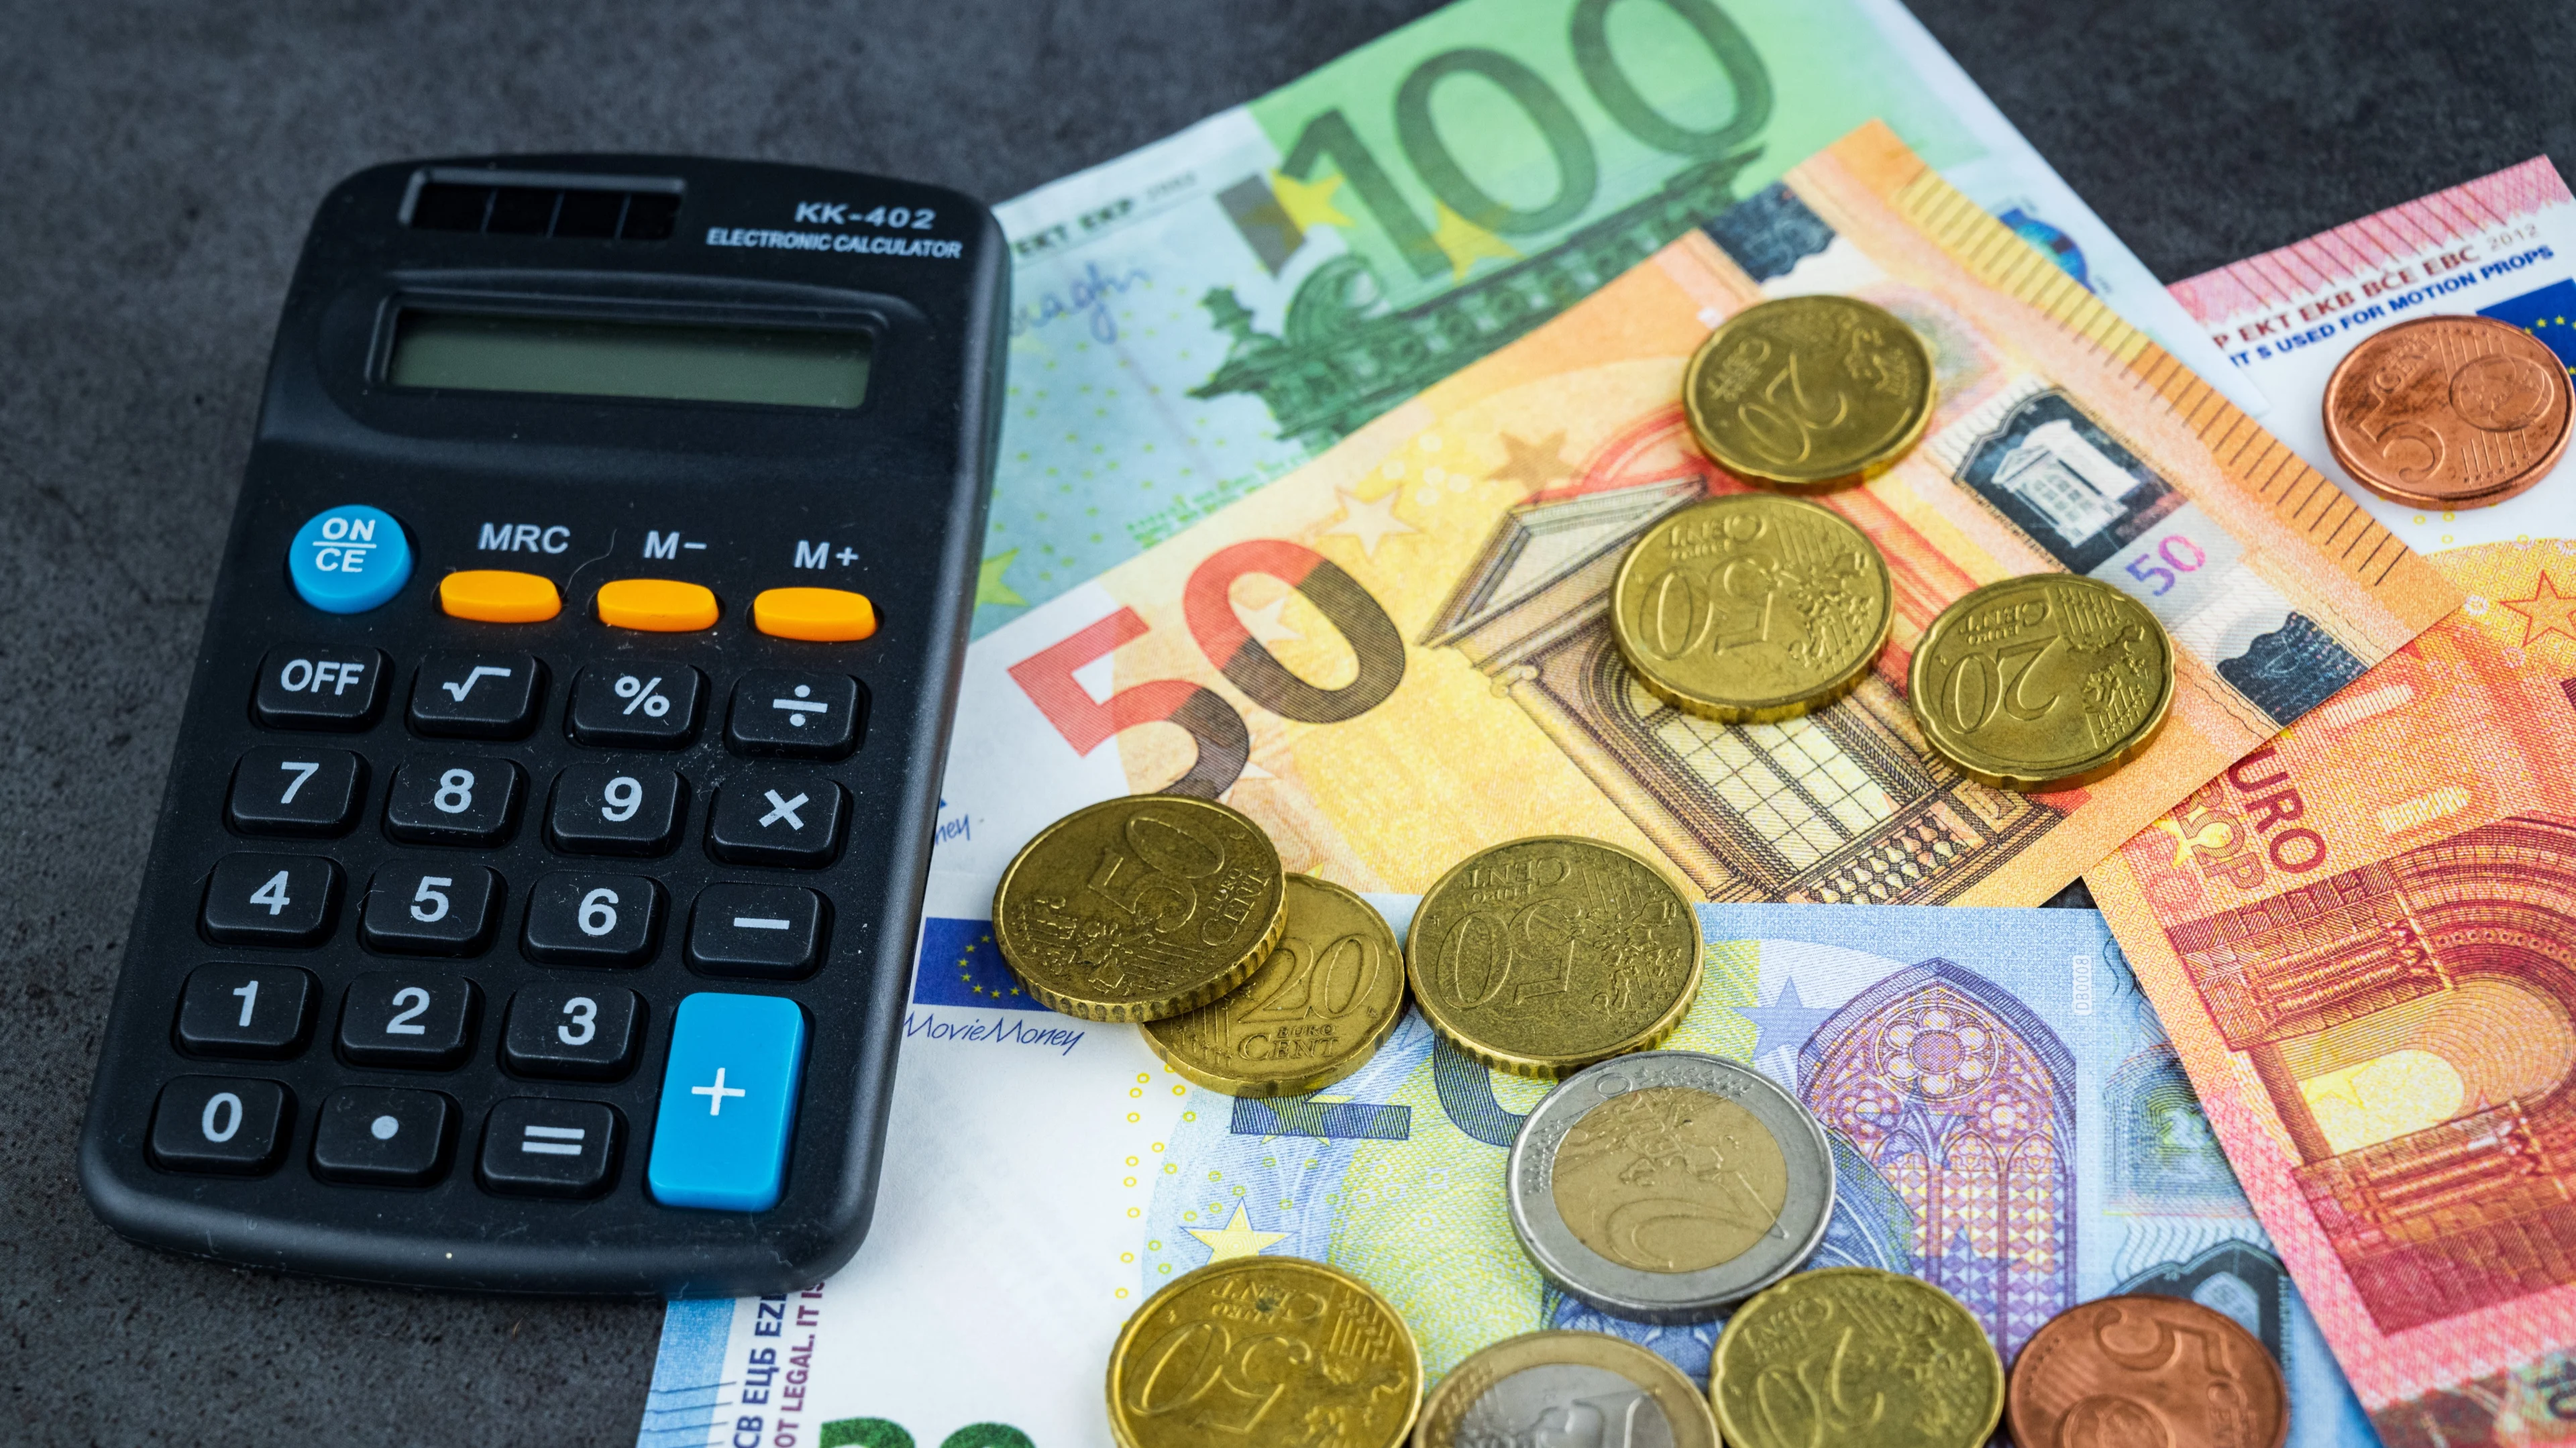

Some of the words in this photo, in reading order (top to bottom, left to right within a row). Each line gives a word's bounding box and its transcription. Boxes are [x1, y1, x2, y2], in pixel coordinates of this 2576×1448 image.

[1278, 0, 1774, 280] 100
[794, 201, 936, 230] KK-402
[706, 227, 832, 252] ELECTRONIC
[833, 234, 963, 260] CALCULATOR
[2237, 314, 2292, 342] EKT
[2298, 290, 2356, 323] EKB
[2422, 243, 2481, 277] EBC
[2486, 222, 2540, 252] 2012
[2275, 321, 2337, 353] USED
[2338, 304, 2387, 331] FOR
[2386, 270, 2478, 313] MOTION
[2479, 243, 2555, 280] PROPS
[1737, 352, 1849, 465] 20
[2359, 389, 2447, 484] 5
[322, 516, 375, 542] ON
[478, 522, 571, 555] MRC
[315, 547, 366, 574] CE
[2125, 533, 2206, 598] 50
[1638, 554, 1782, 662] 50
[1957, 601, 2051, 635] CENT
[280, 658, 366, 696] OFF
[1007, 539, 1406, 801] 50
[1940, 635, 2059, 736] 20
[280, 761, 320, 805] 7
[433, 767, 476, 814] 8
[600, 775, 643, 822] 9
[2226, 747, 2328, 876] URO
[249, 870, 291, 916] 4
[1087, 810, 1226, 936] 50
[1460, 856, 1572, 890] CENT
[1471, 883, 1532, 905] EURO
[409, 875, 453, 923] 5
[577, 887, 620, 937] 6
[1203, 872, 1271, 947] CENT
[1436, 897, 1582, 1010] 50
[232, 979, 260, 1027] 1
[1236, 934, 1382, 1026] 20
[385, 986, 431, 1036] 2
[557, 996, 598, 1046] 3
[903, 1010, 1085, 1057] MovieMoney
[1275, 1023, 1339, 1038] EURO
[1236, 1032, 1342, 1063] CENT
[201, 1092, 244, 1144] 0
[796, 1304, 820, 1327] IT
[2092, 1306, 2241, 1380] 5
[780, 1333, 816, 1413] LEGAL.
[1124, 1318, 1313, 1437] 50
[1747, 1325, 1885, 1448] 20
